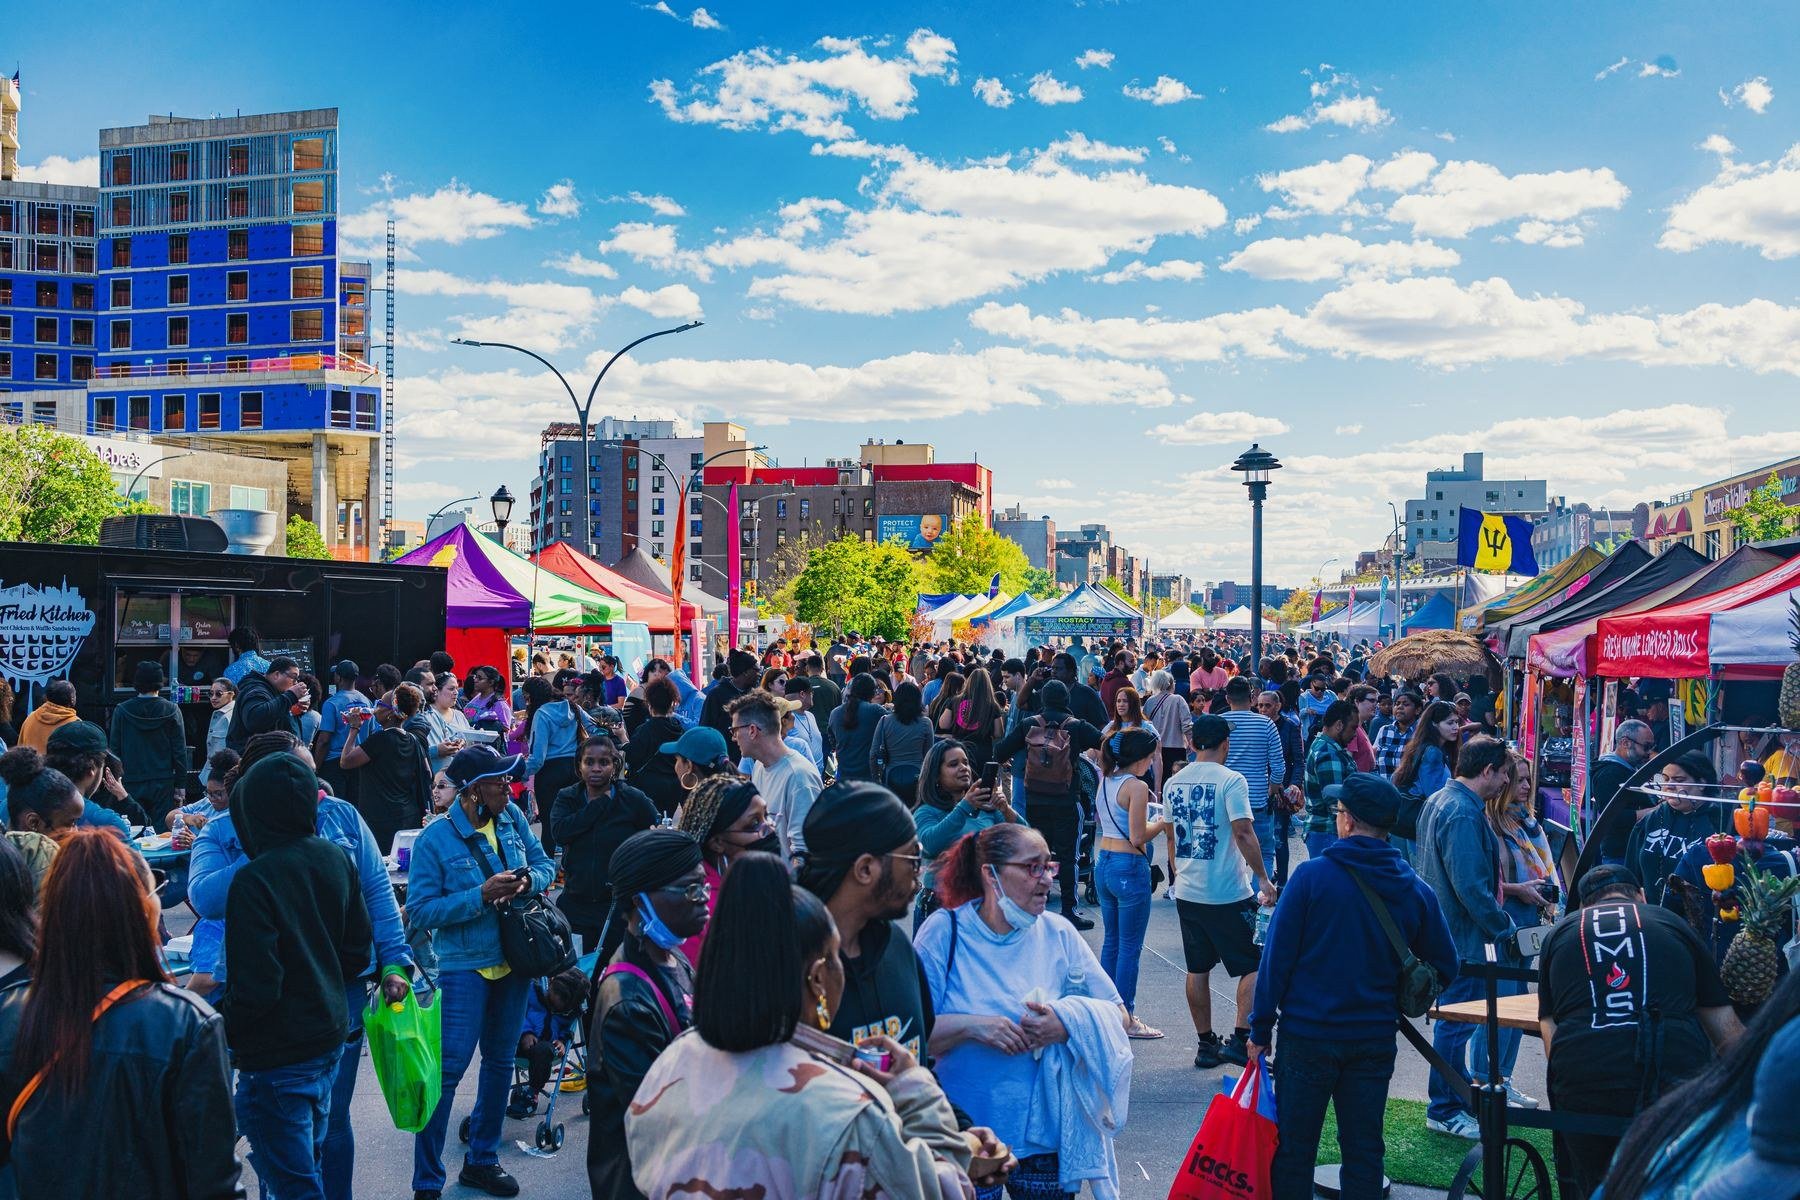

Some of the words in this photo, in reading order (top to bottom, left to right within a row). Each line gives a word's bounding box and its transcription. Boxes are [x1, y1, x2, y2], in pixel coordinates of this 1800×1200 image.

[40, 605, 91, 623] Kitchen
[195, 621, 212, 629] Order
[1603, 633, 1621, 660] FRESH
[1641, 629, 1671, 660] LOBSTER
[1671, 629, 1698, 660] ROLLS
